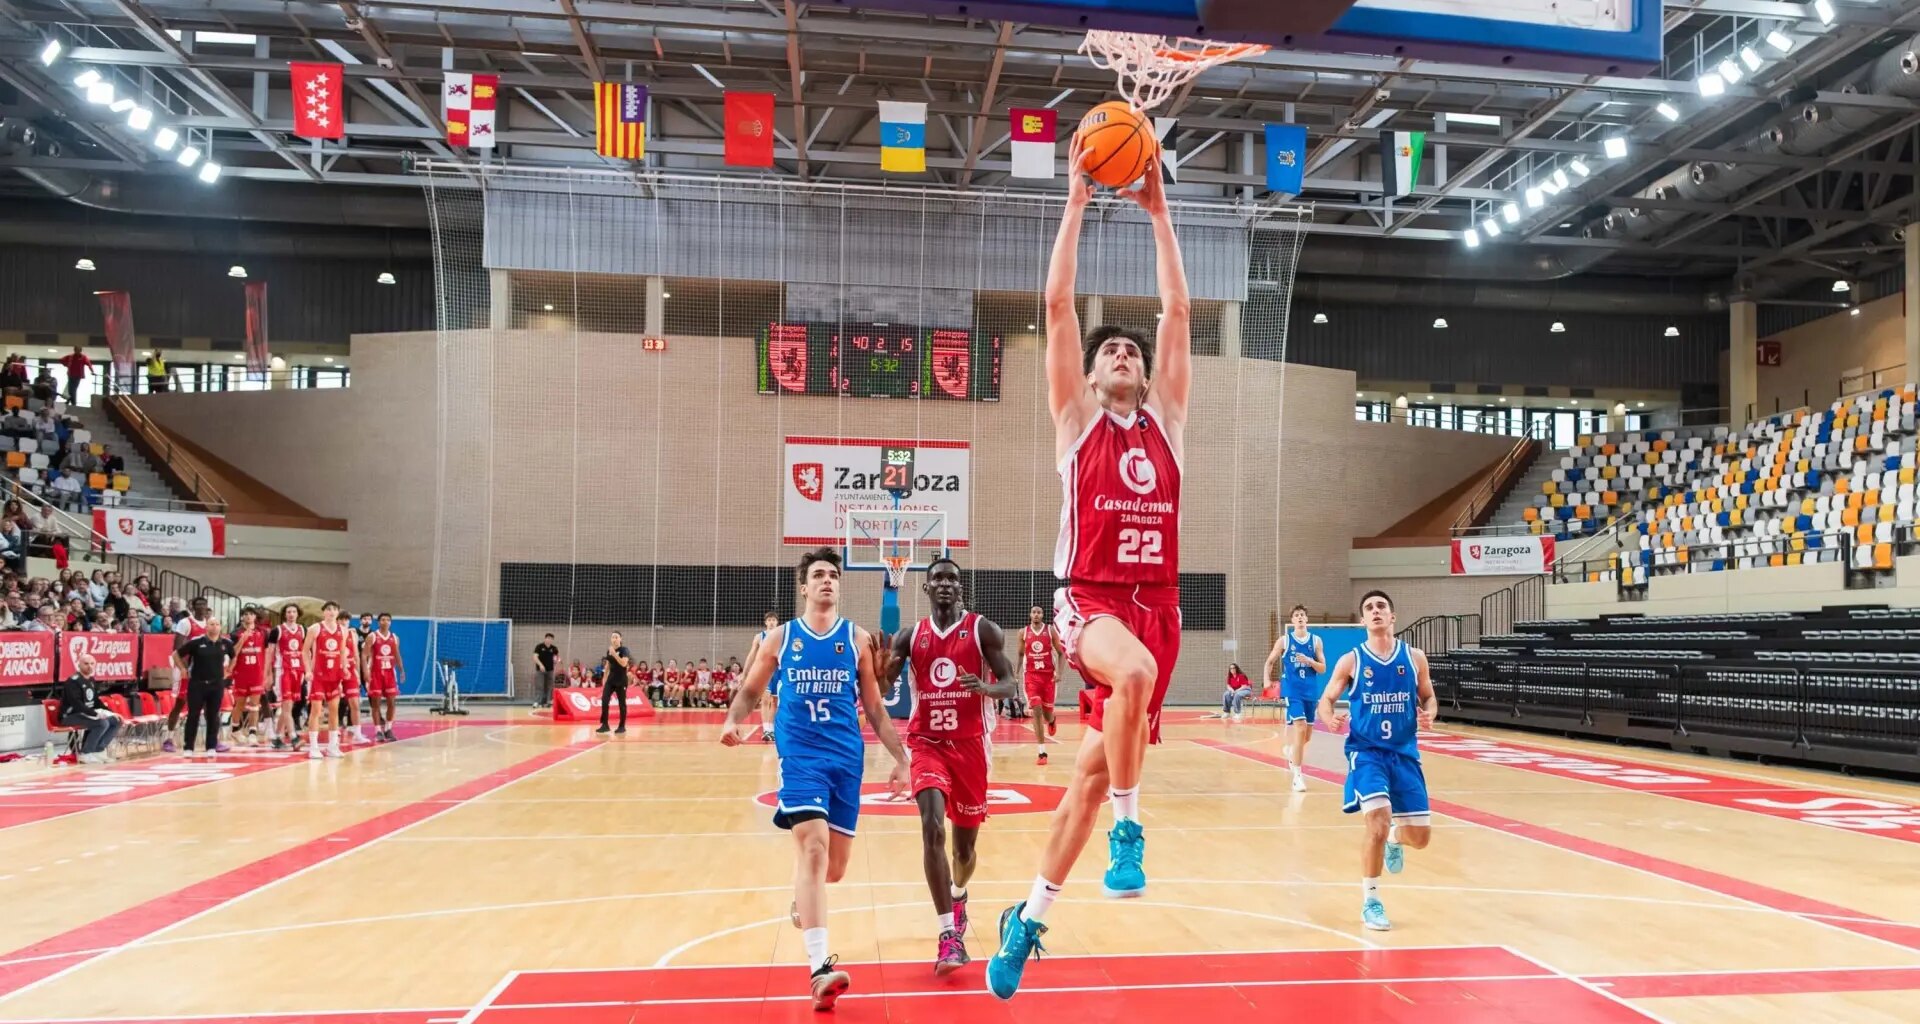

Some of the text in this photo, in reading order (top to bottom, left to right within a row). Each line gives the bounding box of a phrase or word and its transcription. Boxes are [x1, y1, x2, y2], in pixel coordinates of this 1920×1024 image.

[853, 336, 869, 349] 40
[877, 337, 884, 349] 2
[901, 338, 912, 351] 15
[871, 359, 899, 372] 5:32
[842, 378, 849, 389] 2
[911, 381, 918, 392] 3
[887, 450, 911, 461] 5:32
[884, 464, 908, 486] 21
[834, 467, 960, 499] Zaroza
[138, 520, 196, 536] Zaragoza
[1118, 528, 1164, 564] 22
[1484, 545, 1531, 557] Zaragoza
[92, 661, 133, 676] EPORTE
[787, 666, 850, 682] Emirates
[1299, 669, 1306, 679] 8
[796, 681, 843, 693] FLY BETTER
[1363, 690, 1410, 704] Emirates
[804, 698, 831, 722] 15
[1370, 704, 1382, 714] FLY
[930, 708, 958, 731] 23
[1381, 719, 1392, 740] 9
